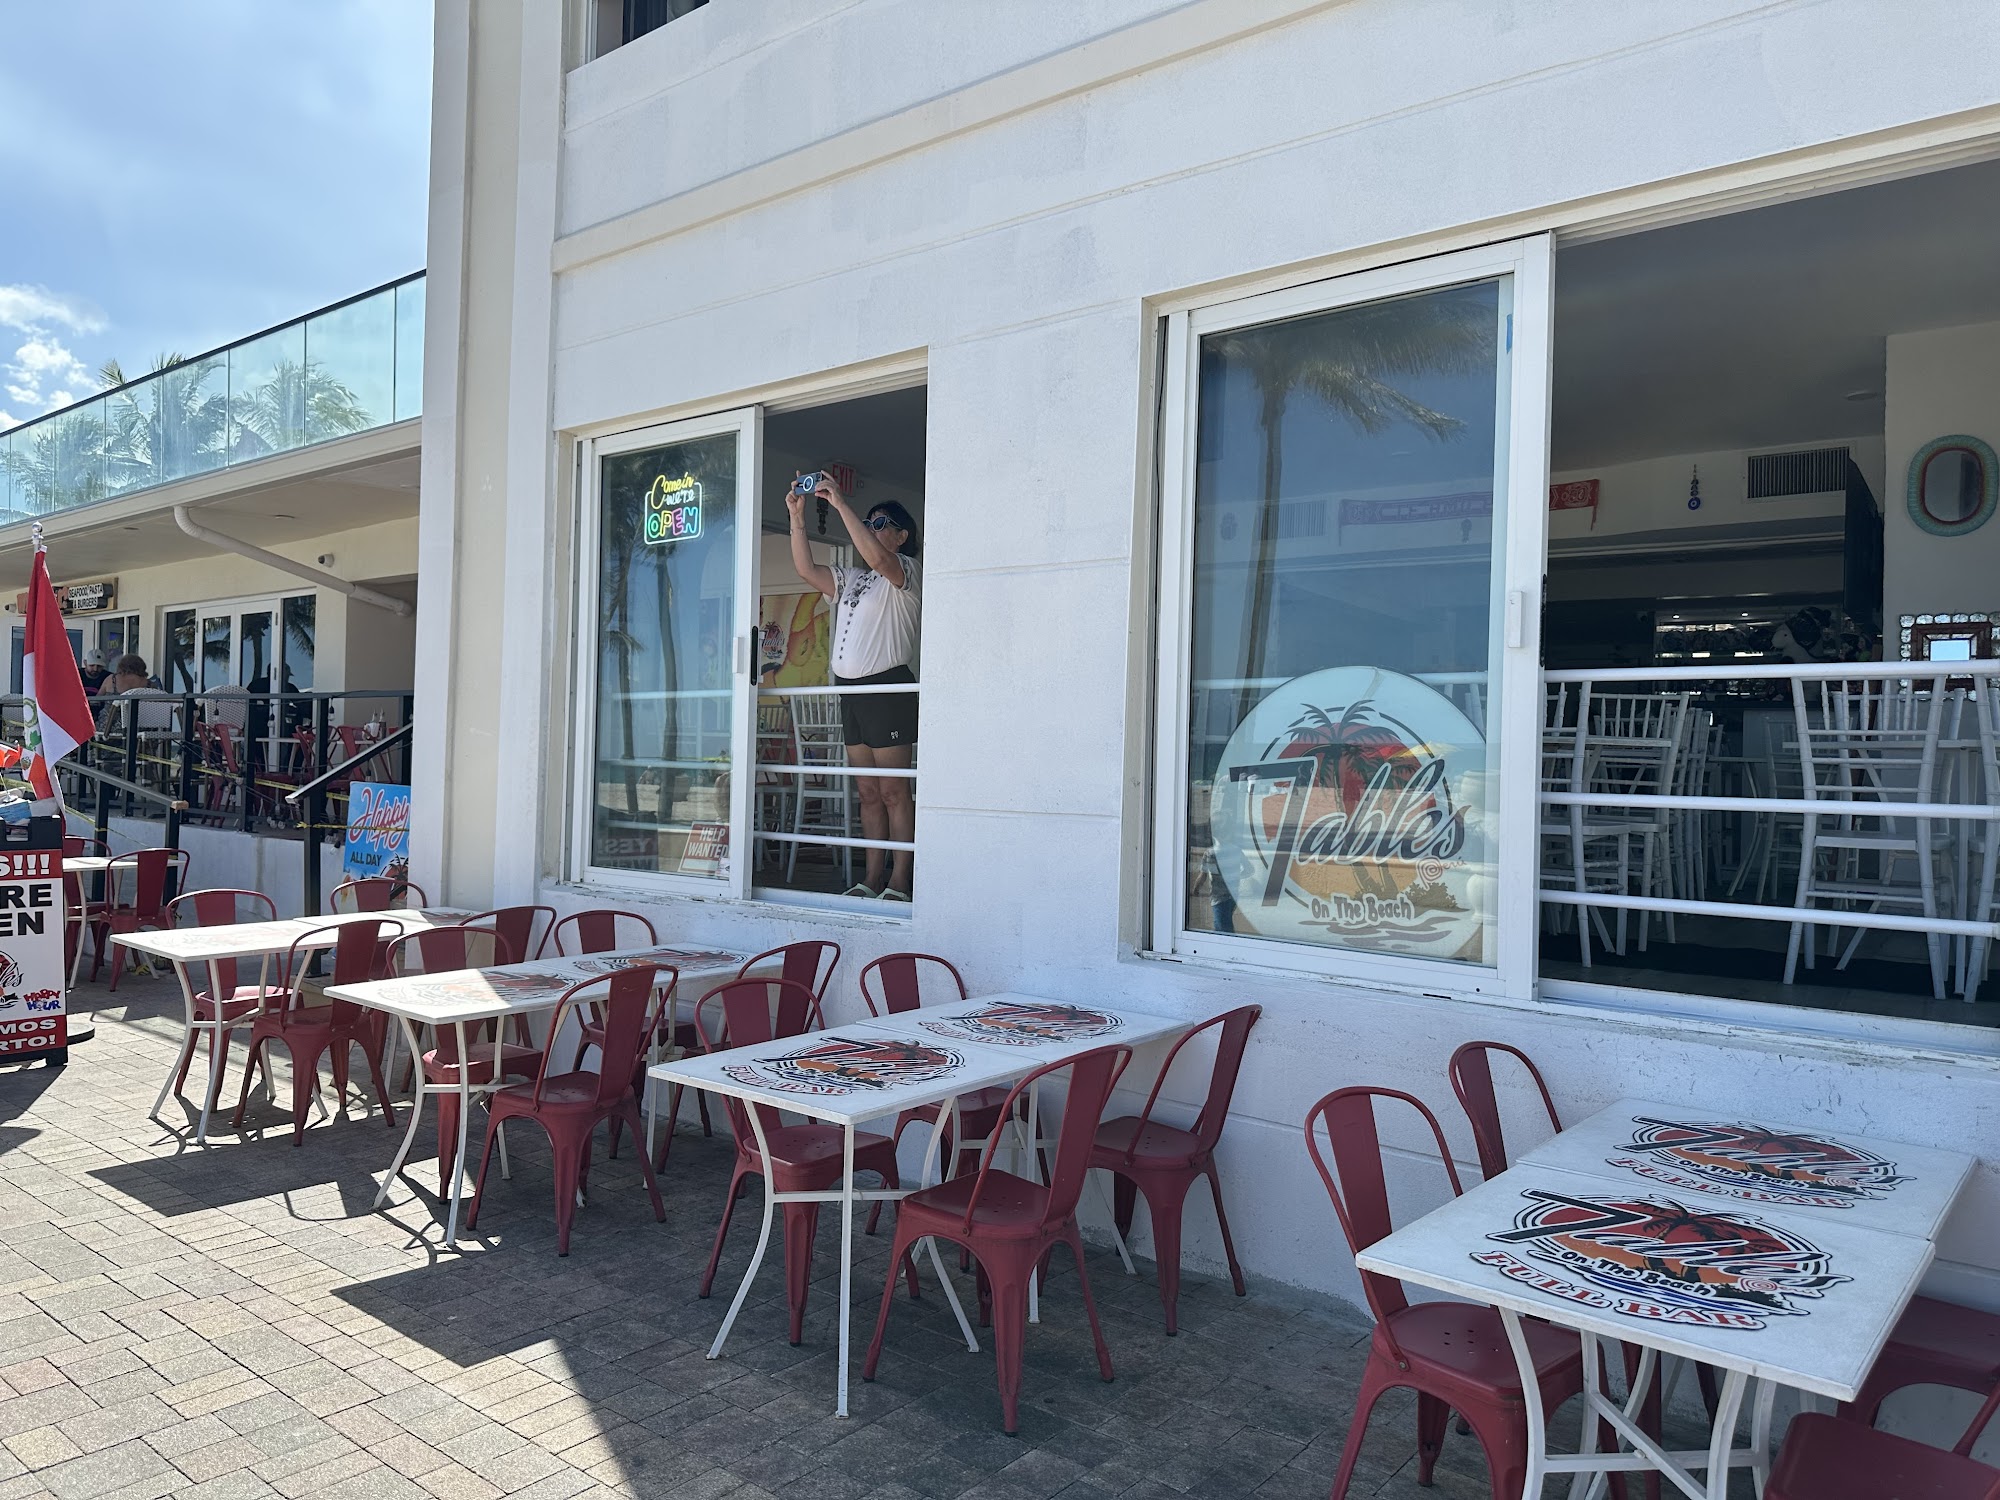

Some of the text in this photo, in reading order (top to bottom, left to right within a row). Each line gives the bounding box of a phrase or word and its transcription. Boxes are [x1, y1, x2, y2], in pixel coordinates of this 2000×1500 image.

[647, 507, 698, 538] OPEN
[89, 584, 103, 595] PASTA
[78, 598, 97, 608] BURGERS
[699, 826, 726, 842] HELP
[350, 852, 382, 867] ALL DAY
[687, 841, 728, 858] WANTED
[1311, 894, 1412, 923] On The Beach
[23, 988, 61, 1003] HAPPY
[1614, 1158, 1848, 1207] FULL BAR
[1678, 1159, 1806, 1188] On The Beach
[1560, 1249, 1714, 1297] On The Beach
[1480, 1252, 1760, 1328] FULL BAR
